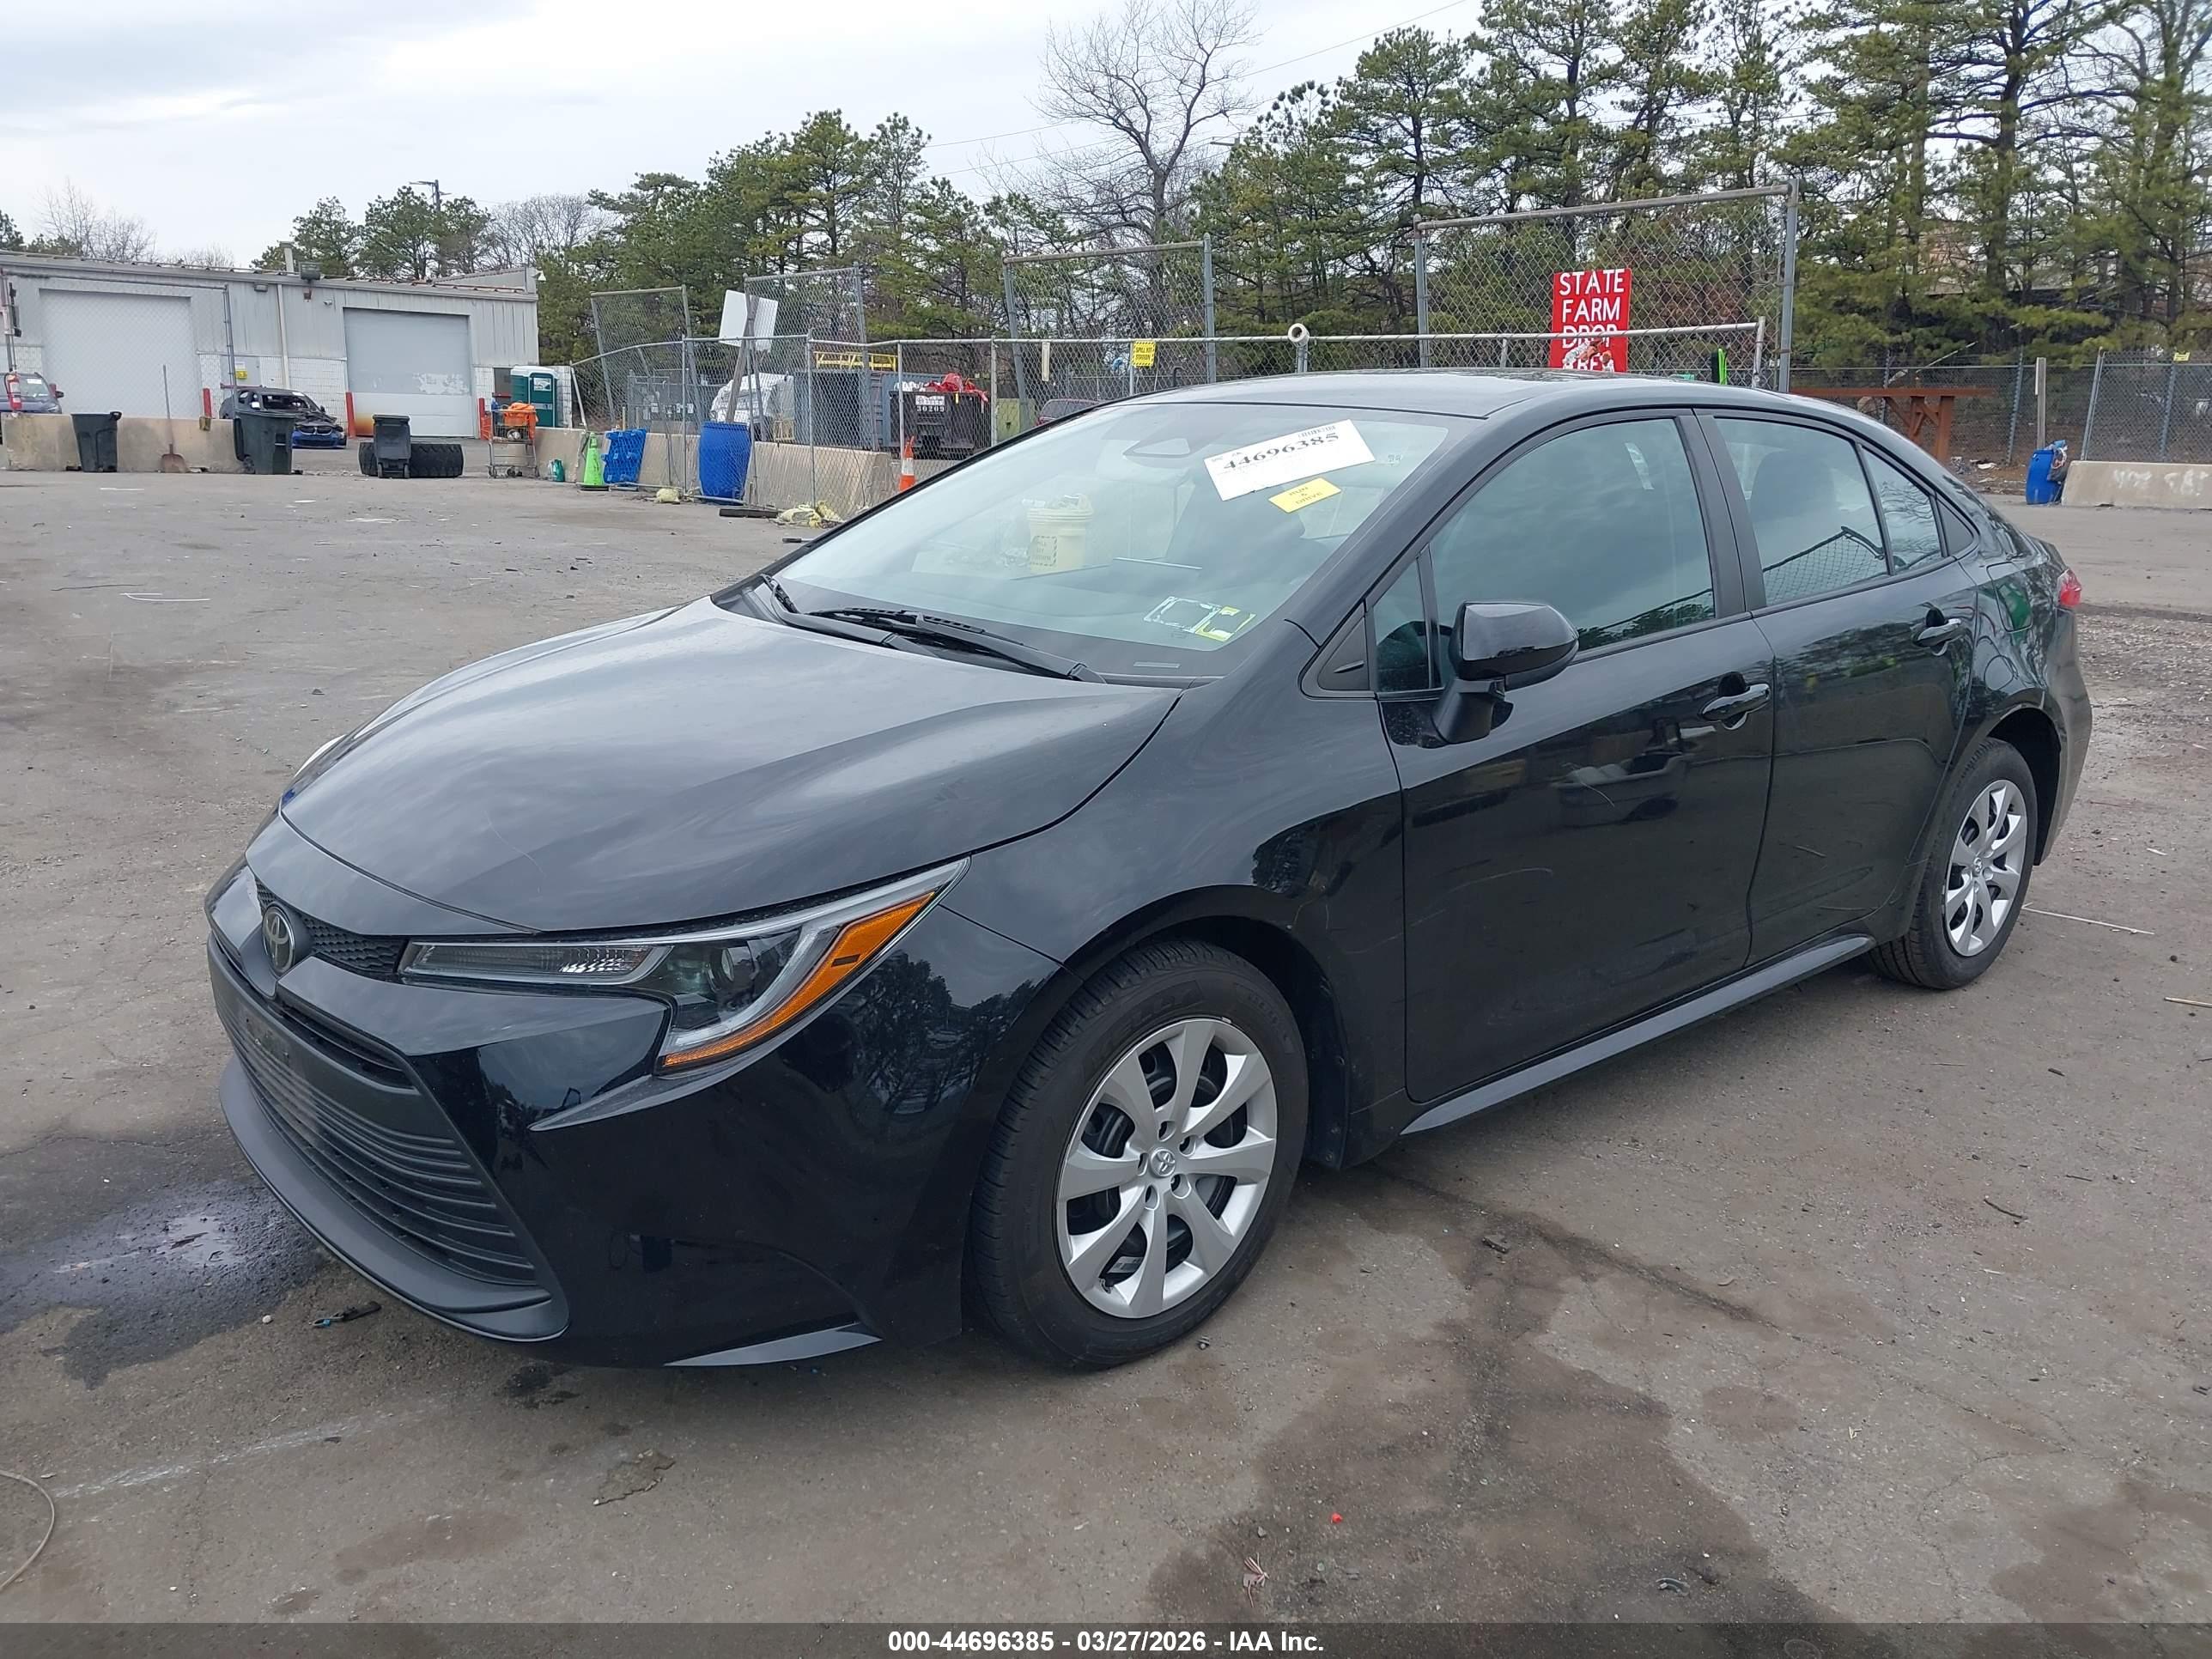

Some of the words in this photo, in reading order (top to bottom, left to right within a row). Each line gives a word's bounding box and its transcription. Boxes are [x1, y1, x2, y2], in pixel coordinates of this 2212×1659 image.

[1559, 269, 1625, 295] STATE
[1562, 296, 1621, 323] FARM
[1224, 432, 1339, 470] 44696385
